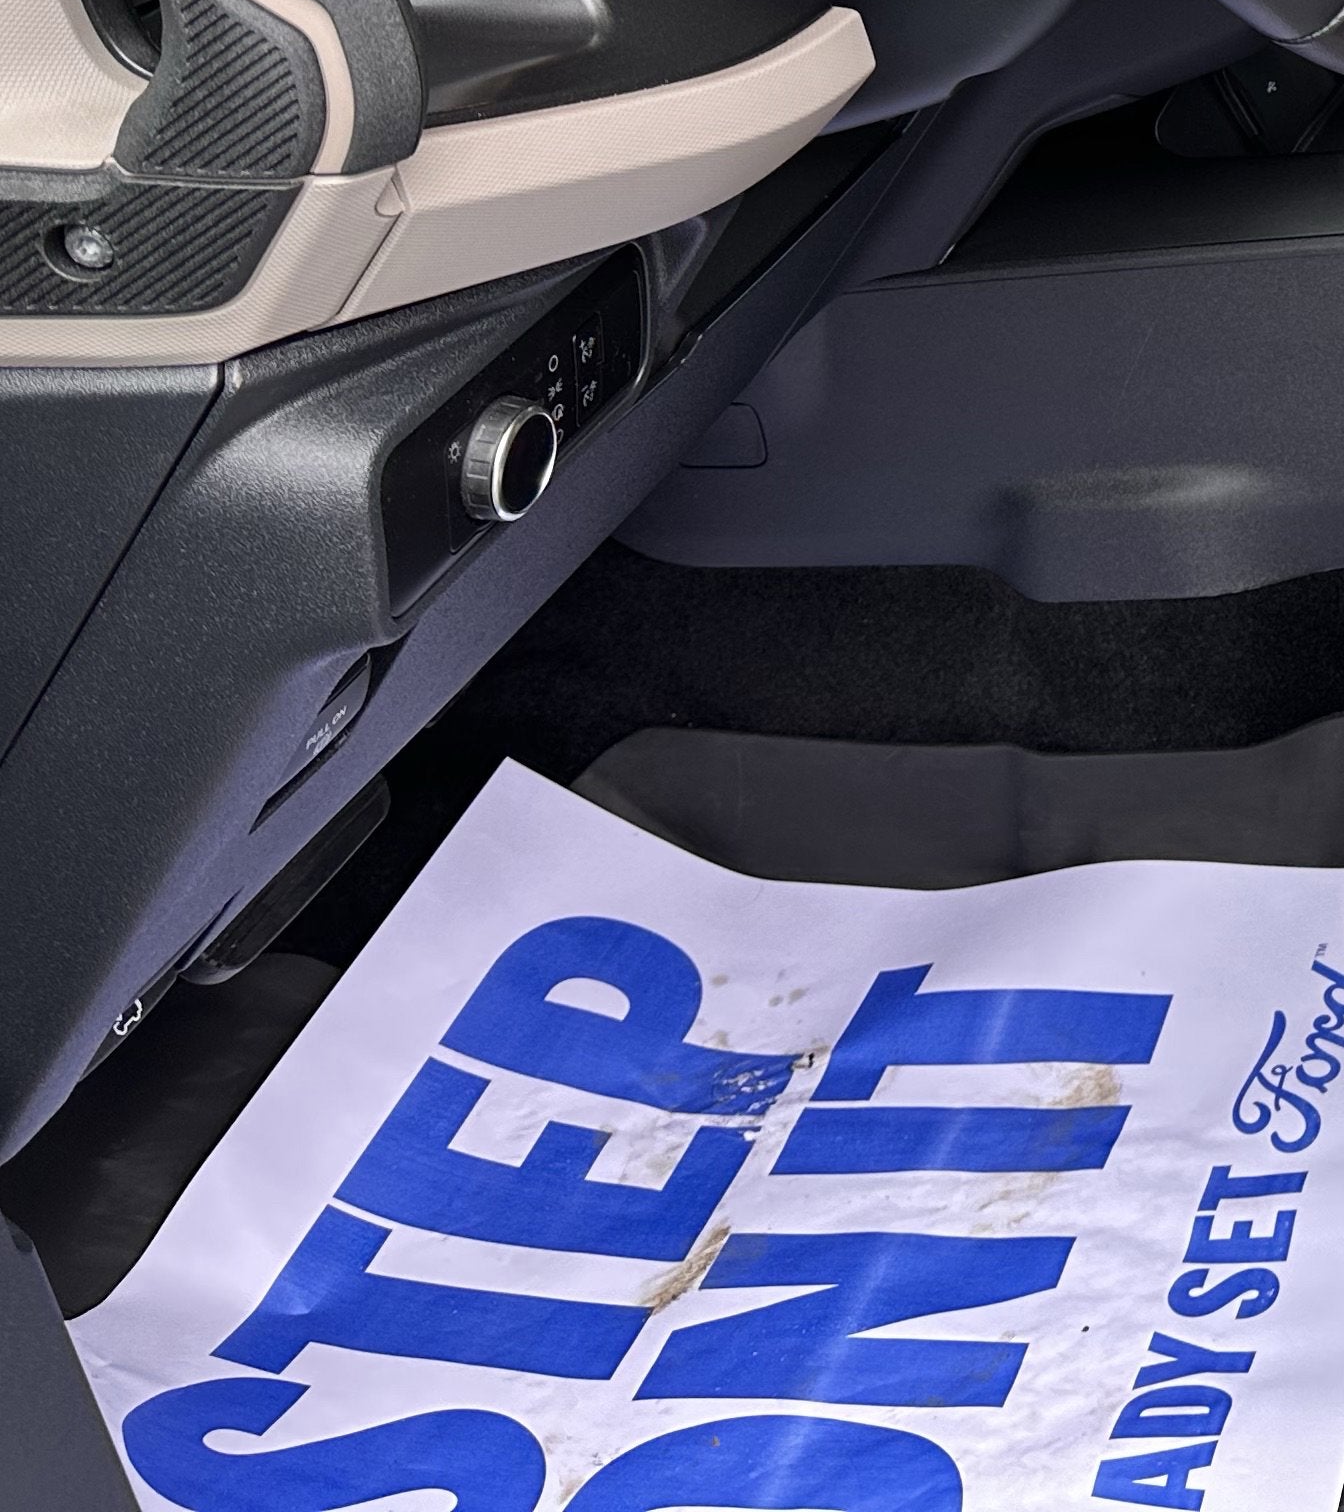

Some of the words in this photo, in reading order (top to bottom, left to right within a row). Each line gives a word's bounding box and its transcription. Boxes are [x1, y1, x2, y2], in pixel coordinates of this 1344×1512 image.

[306, 723, 331, 750] PULL
[332, 705, 347, 725] ON
[769, 962, 1172, 1174] IT
[122, 915, 803, 1512] STEP
[1168, 1165, 1307, 1320] SET
[563, 1233, 1077, 1512] ON
